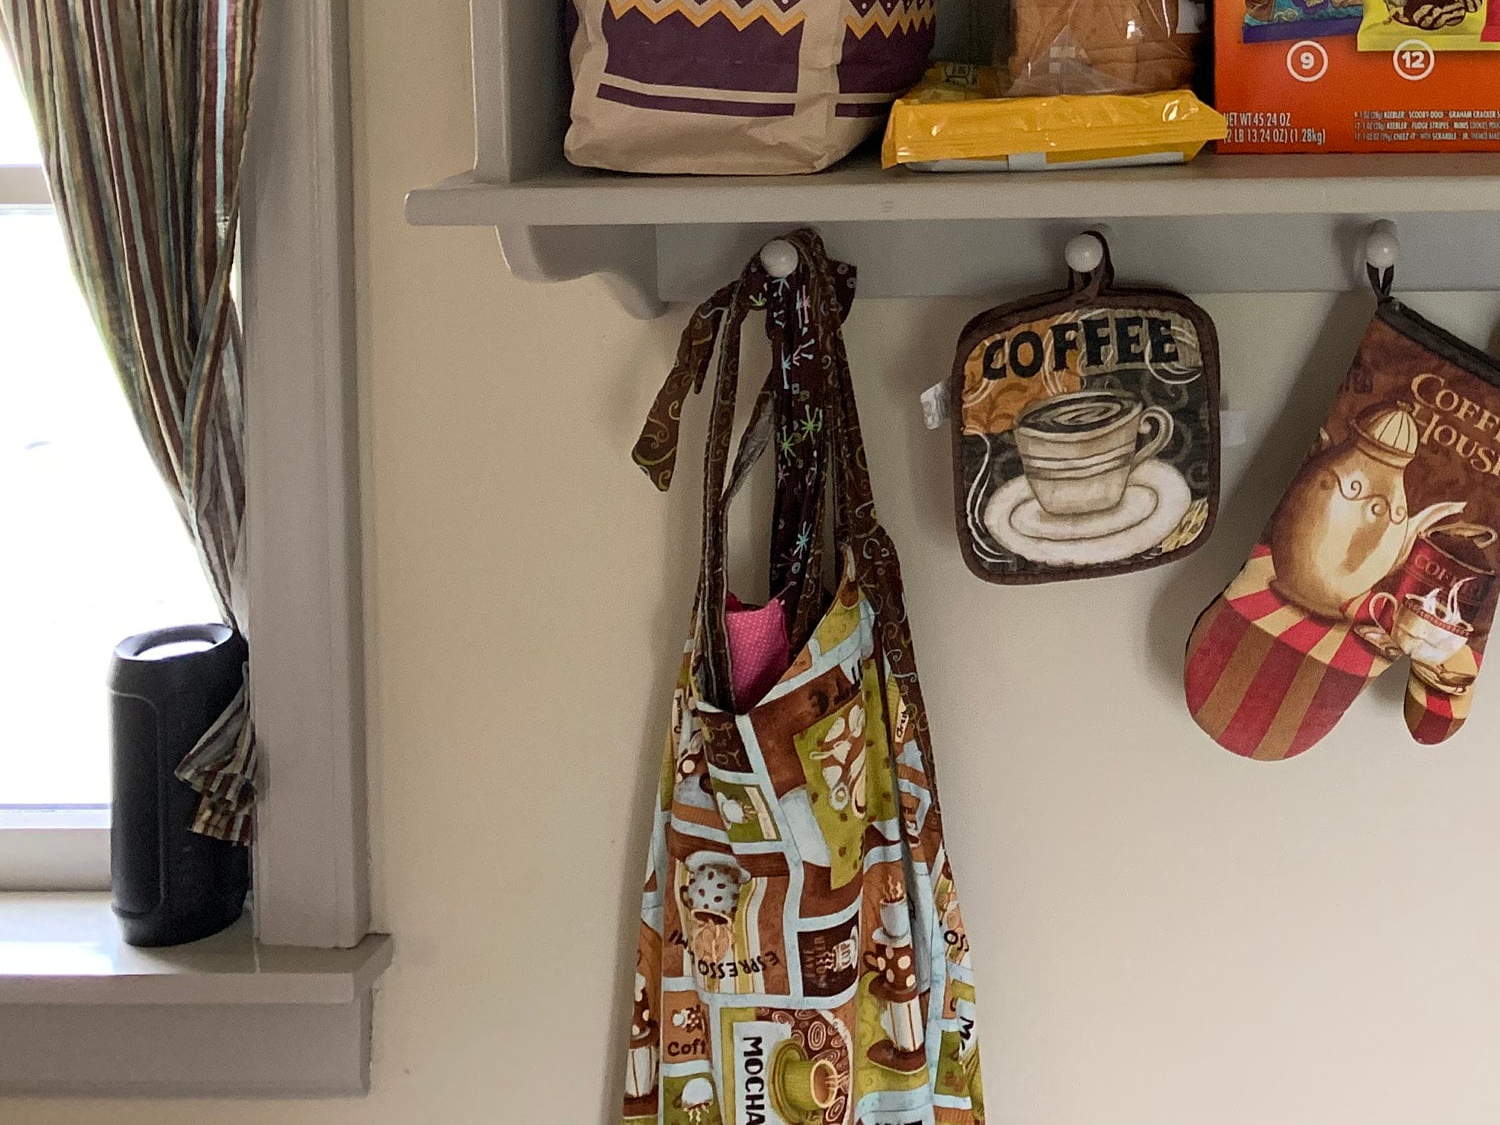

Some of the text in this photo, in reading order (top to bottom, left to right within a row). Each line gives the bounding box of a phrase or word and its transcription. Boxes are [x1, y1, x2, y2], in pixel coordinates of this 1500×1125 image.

[1301, 51, 1314, 69] 9
[1401, 51, 1425, 69] 12
[1240, 112, 1253, 126] WT
[1253, 112, 1277, 127] 45.24
[1279, 112, 1291, 126] OZ
[1235, 128, 1244, 142] LB
[1247, 128, 1270, 143] 13.24
[1272, 128, 1288, 143] OZ)
[982, 316, 1180, 380] COFFEE
[697, 949, 780, 980] ESPRESSO
[742, 1035, 768, 1125] MOCHA
